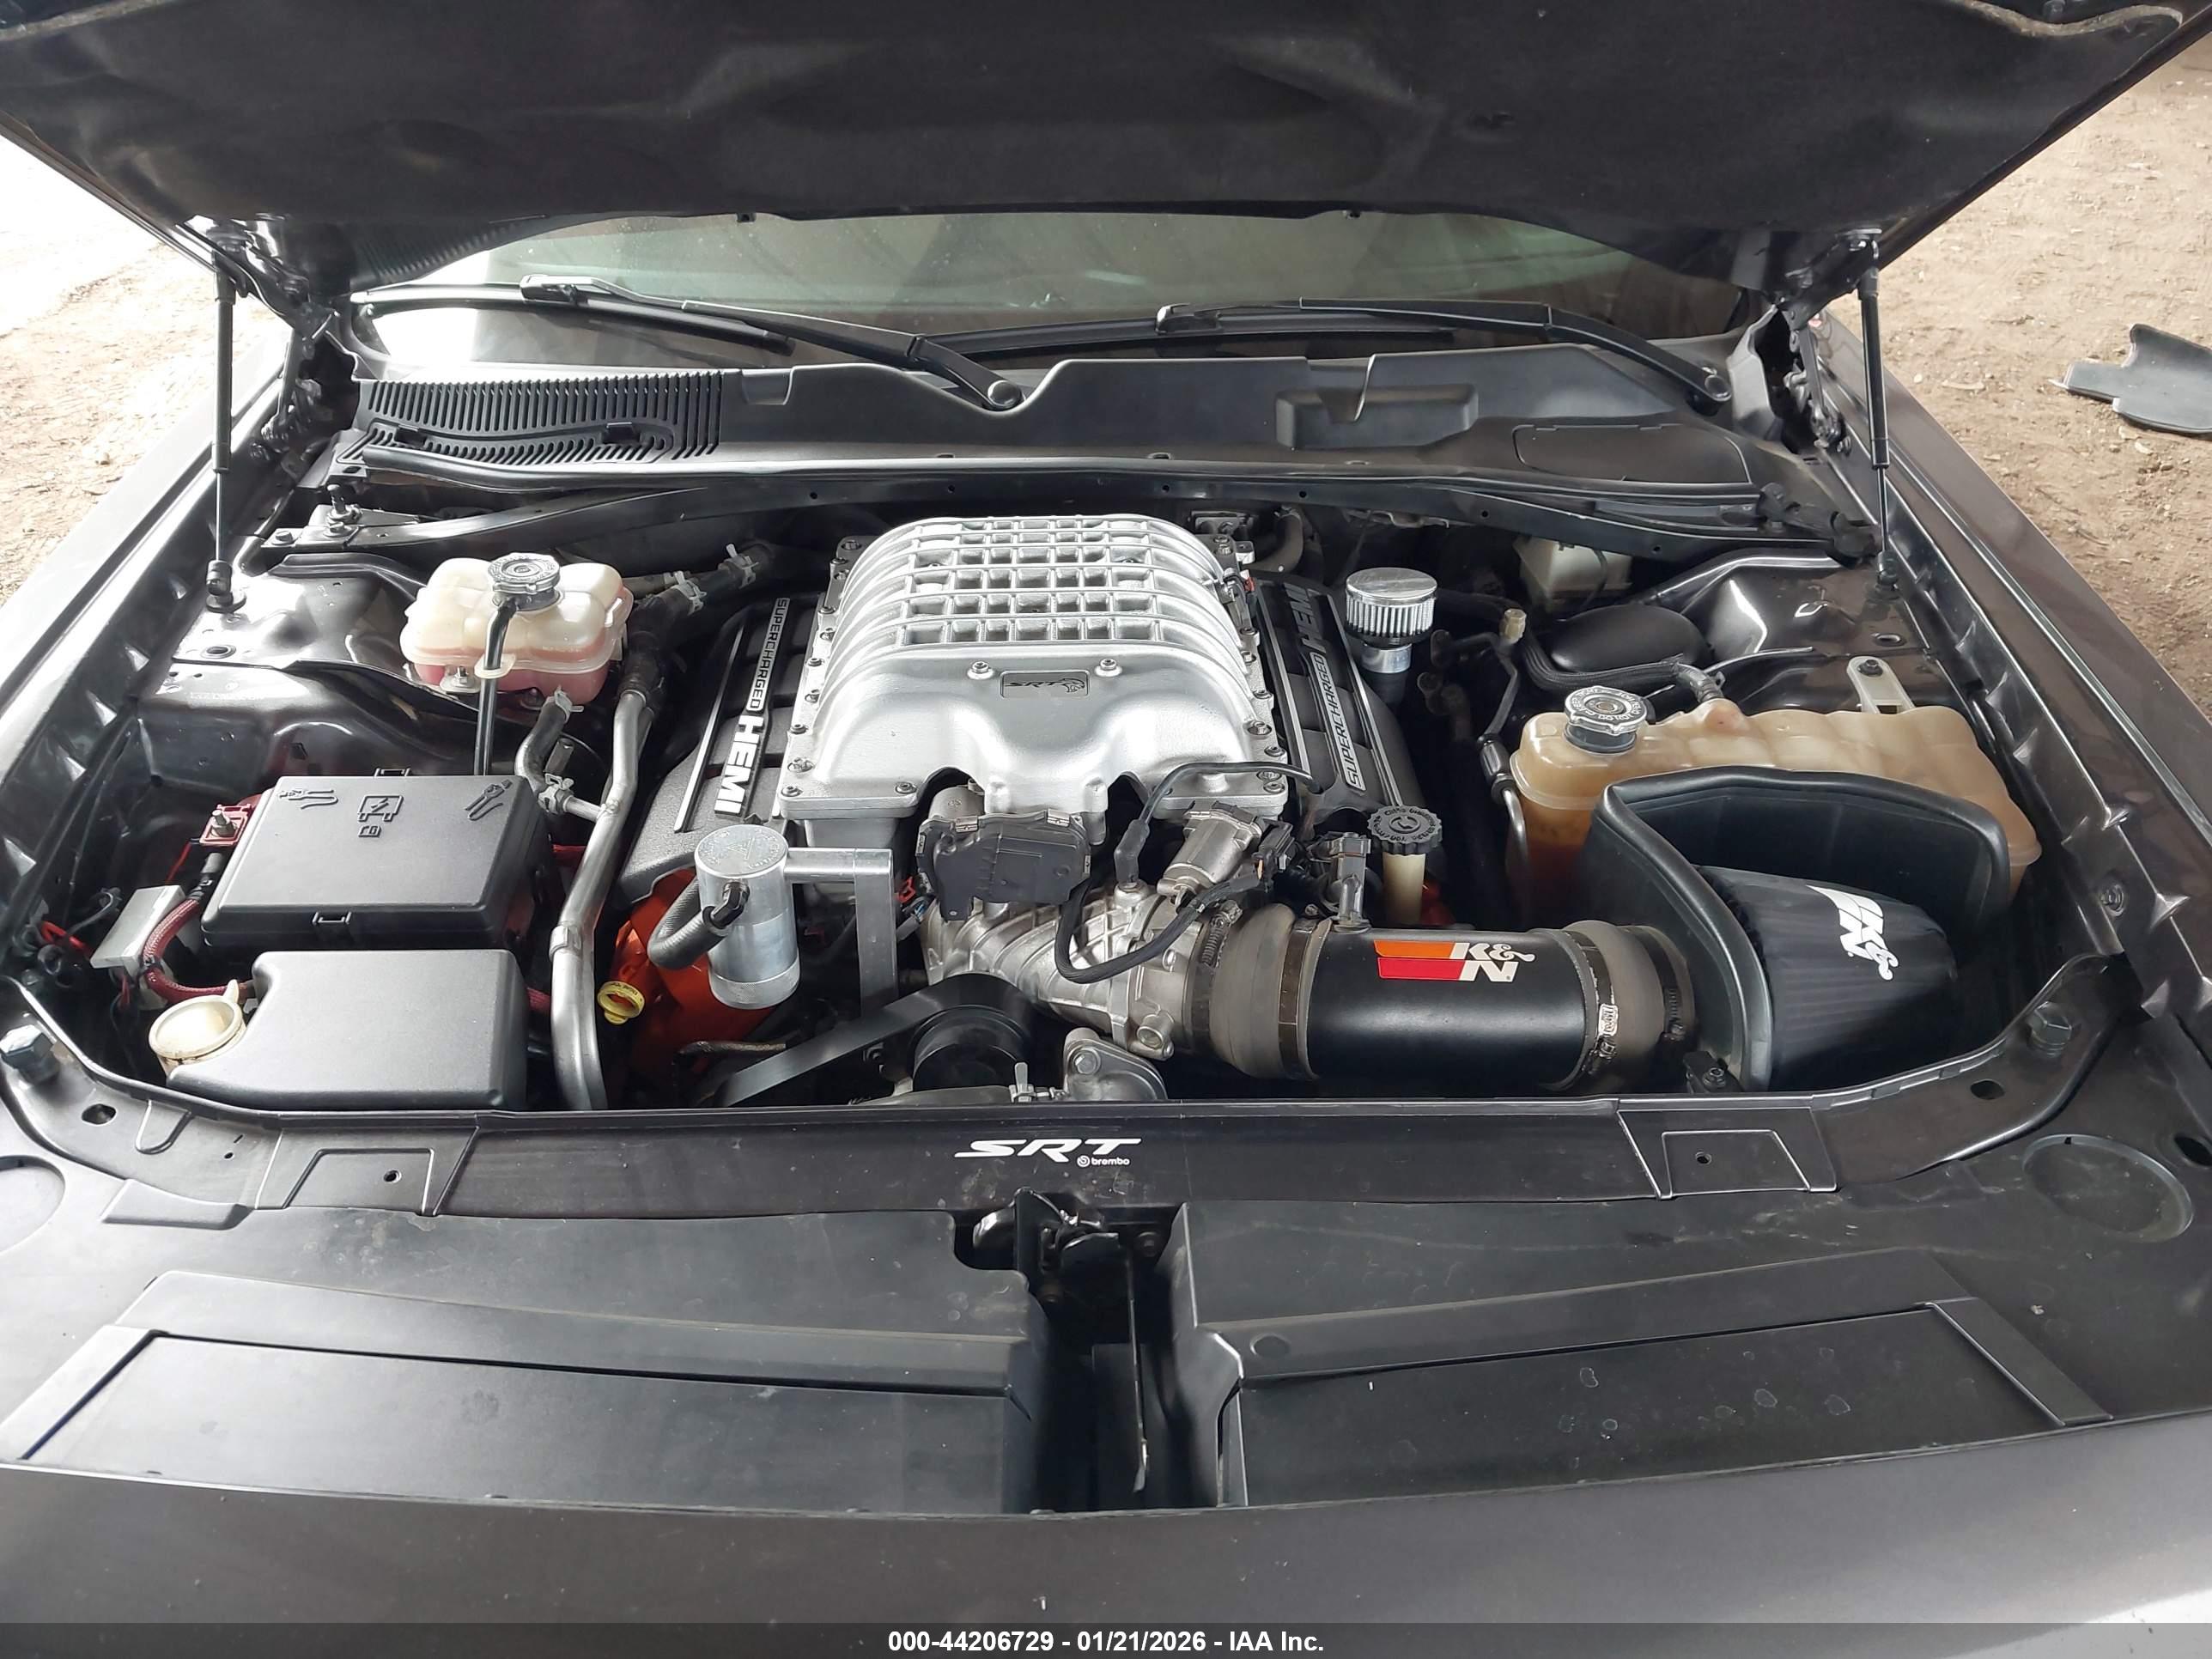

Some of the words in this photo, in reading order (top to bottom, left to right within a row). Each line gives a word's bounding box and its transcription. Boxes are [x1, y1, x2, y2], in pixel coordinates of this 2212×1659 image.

[750, 598, 789, 710] SUPERCHARGED
[1284, 582, 1327, 653] HEMI
[1314, 653, 1364, 790] SUPERCHARGED
[714, 715, 764, 815] HEMI
[954, 1138, 1142, 1163] SRT
[1091, 1156, 1131, 1166] brembo
